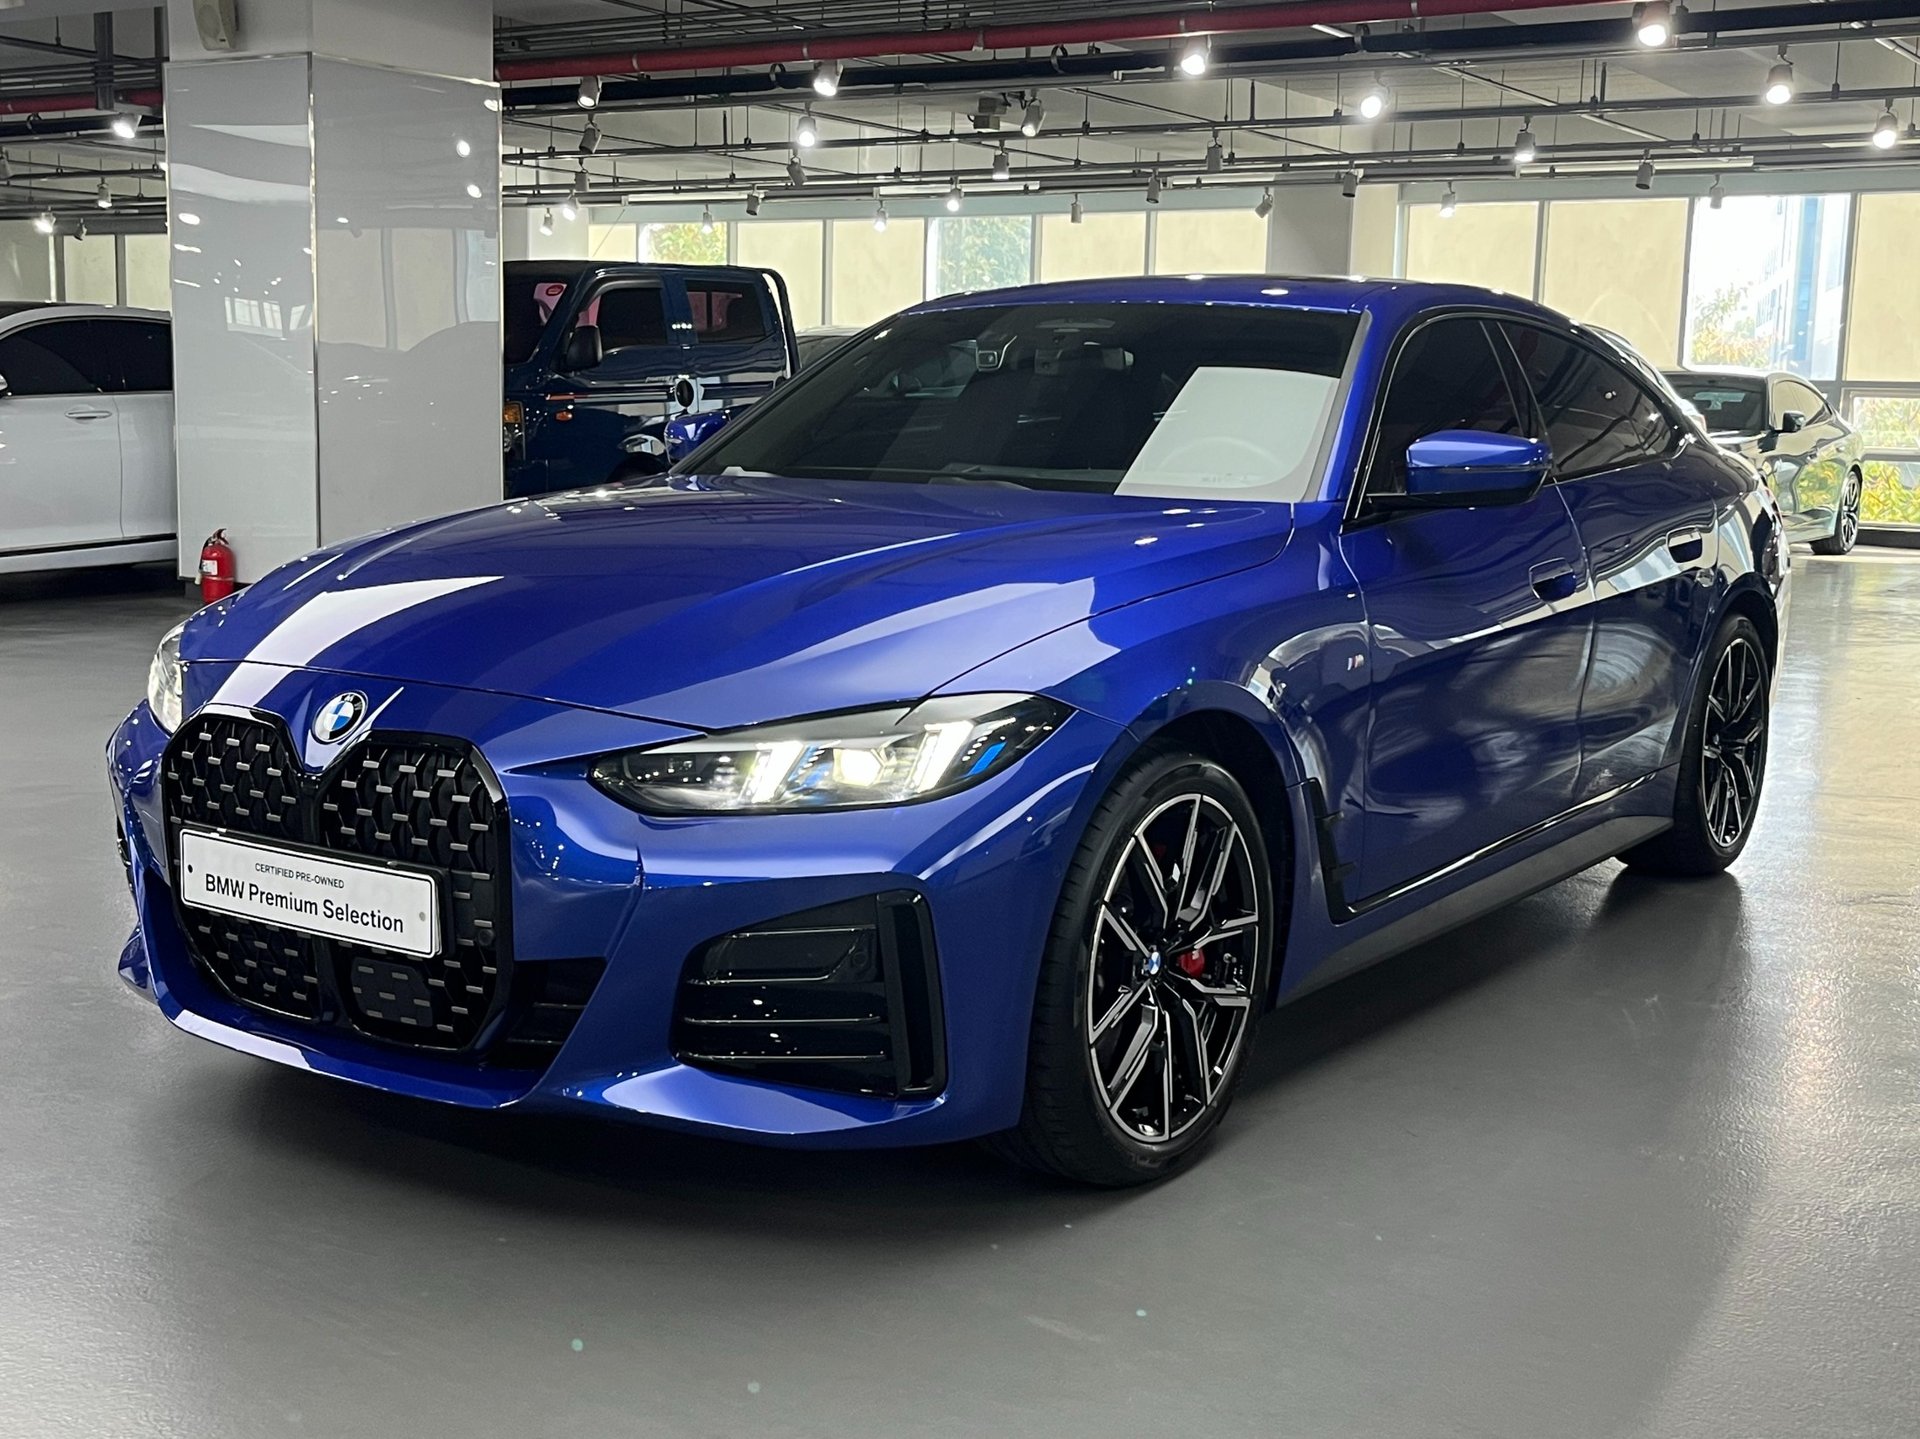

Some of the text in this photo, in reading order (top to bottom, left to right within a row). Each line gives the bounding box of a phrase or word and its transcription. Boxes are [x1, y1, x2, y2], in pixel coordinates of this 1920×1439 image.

[254, 862, 345, 889] CERTIFIED PRE-OWNED
[205, 873, 404, 933] BMW Premium Selection
